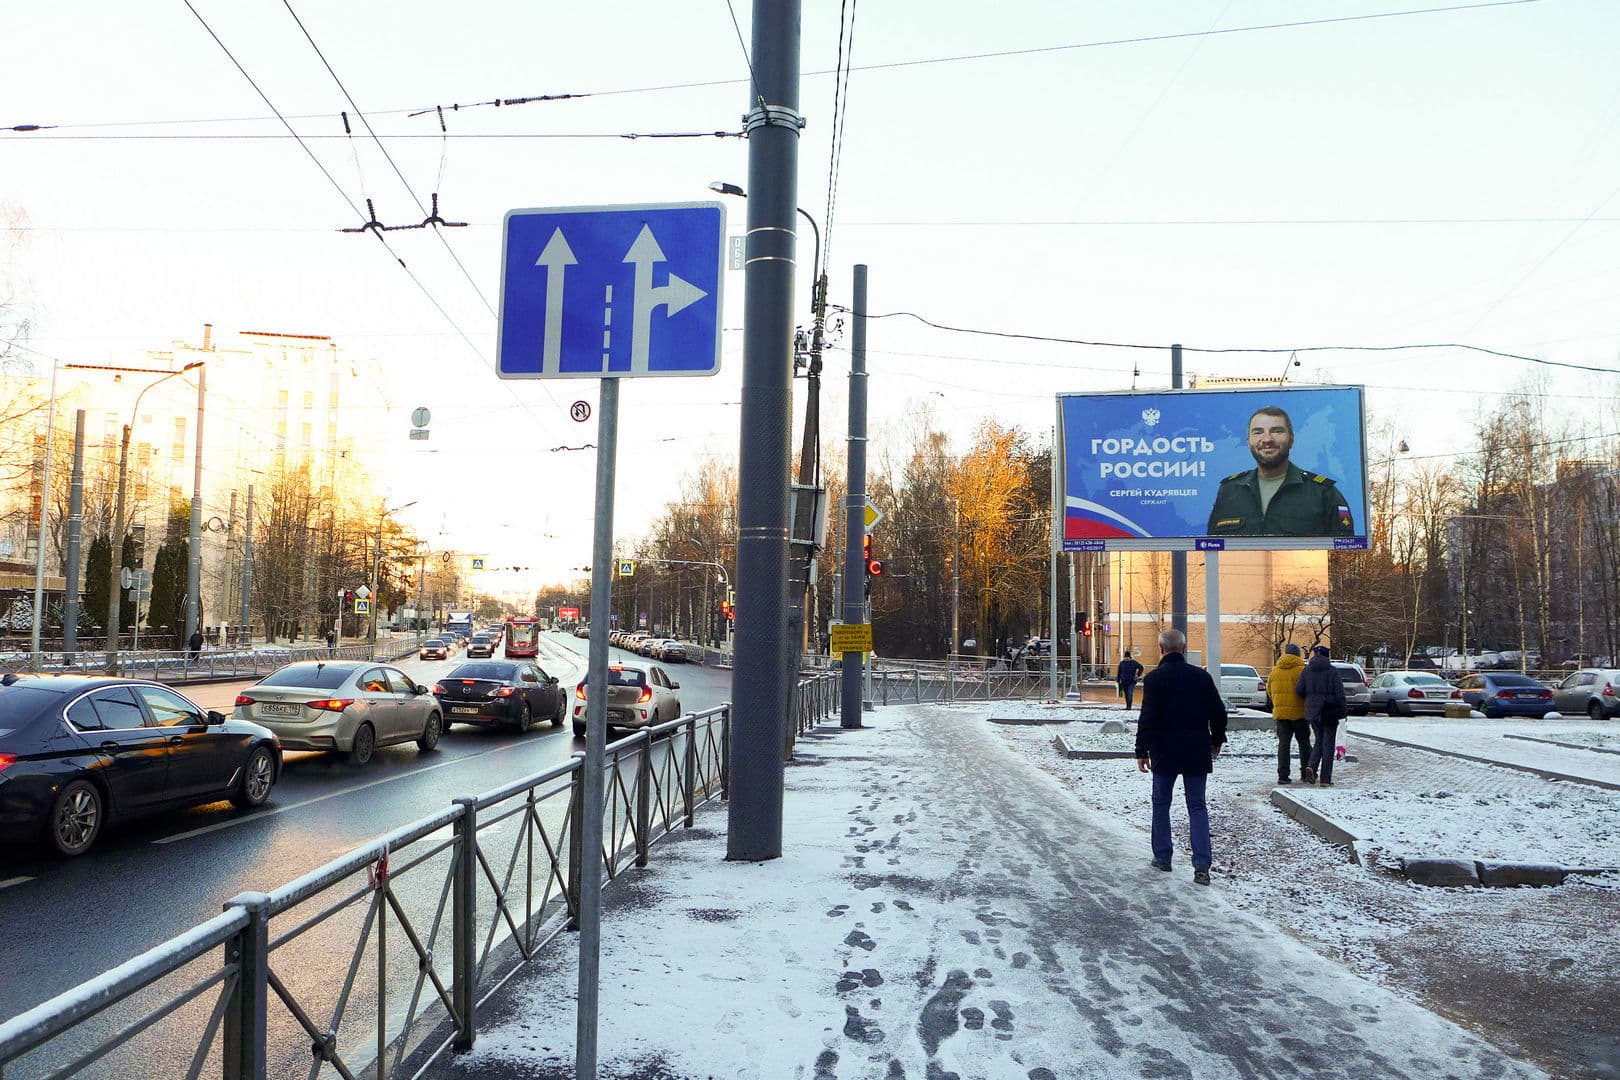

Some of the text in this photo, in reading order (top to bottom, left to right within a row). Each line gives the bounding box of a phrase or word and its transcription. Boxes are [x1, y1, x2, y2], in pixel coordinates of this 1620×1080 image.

[1091, 437, 1215, 456] ГОРДОСТЬ
[1100, 461, 1206, 478] РОССИИ!
[1110, 488, 1198, 497] СЕРГЕЙ КУДРЯВЦЕВ
